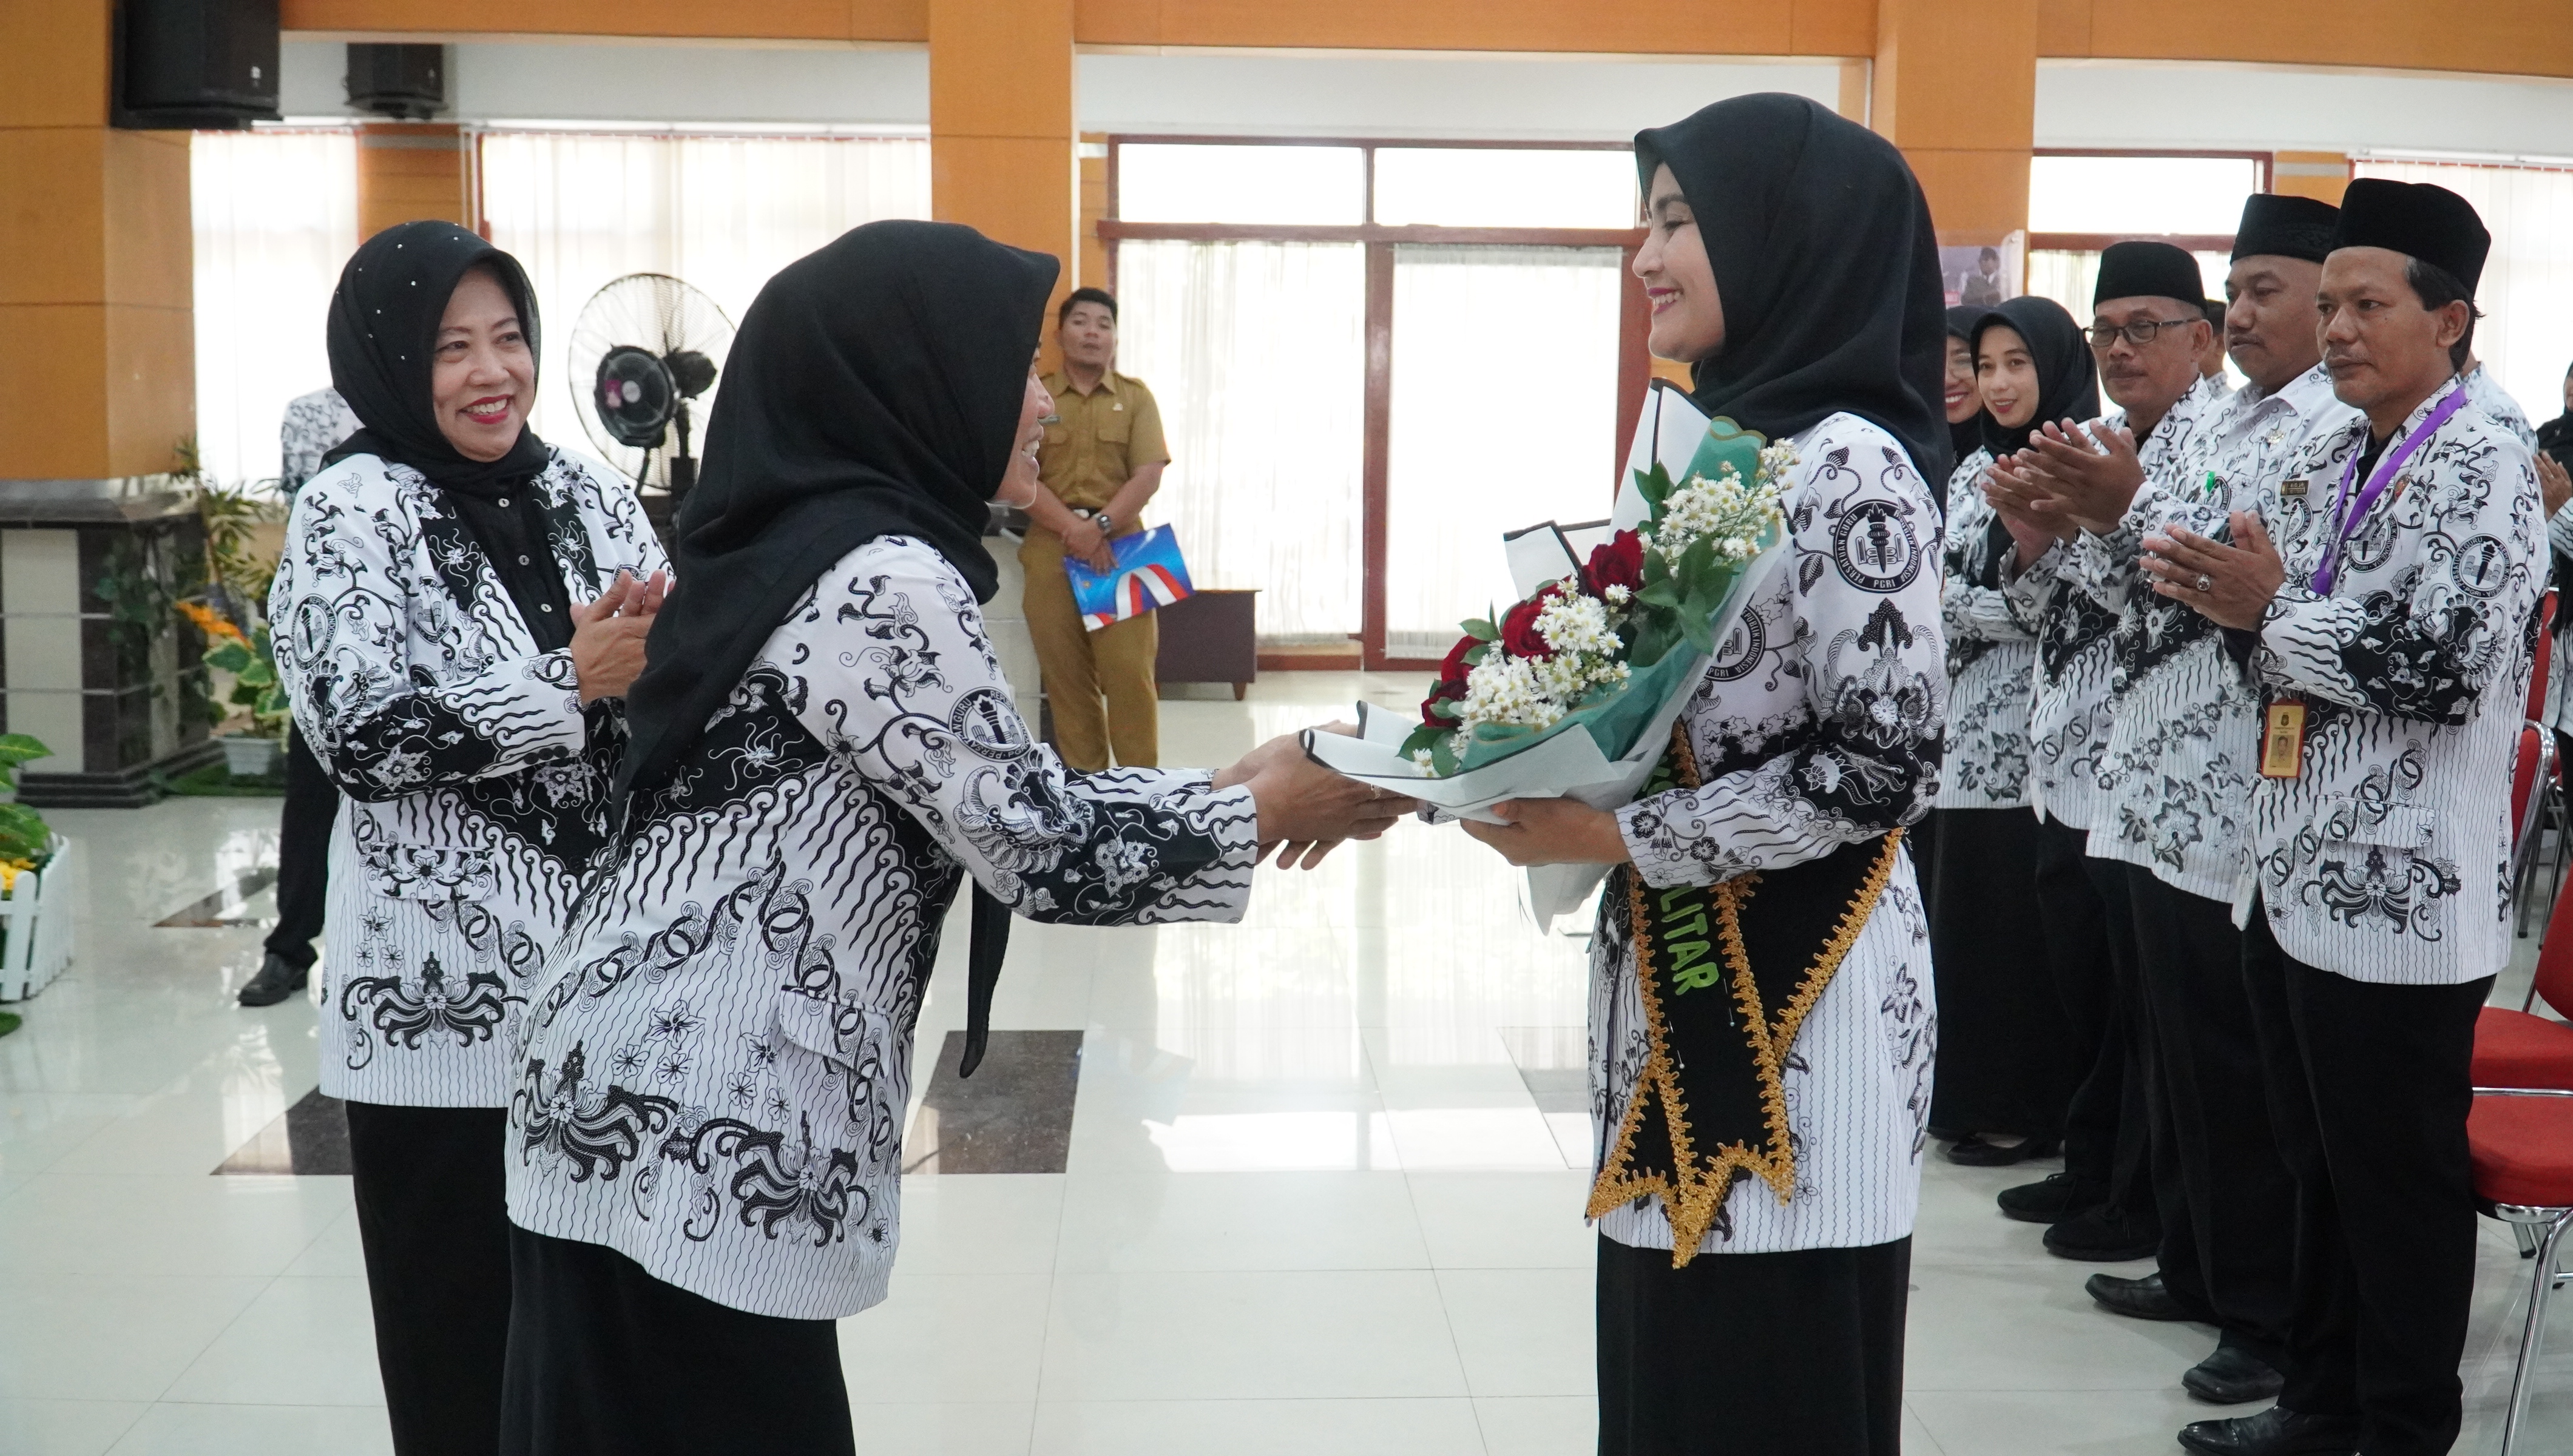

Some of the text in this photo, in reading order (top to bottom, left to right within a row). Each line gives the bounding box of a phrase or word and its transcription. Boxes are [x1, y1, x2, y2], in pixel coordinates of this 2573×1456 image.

[1839, 513, 1858, 536] GURU
[2464, 536, 2483, 548] GURU
[1838, 540, 1865, 584] PERSATUAN
[1901, 546, 1918, 582] INDONESIA
[1873, 579, 1896, 588] PGRI
[2464, 587, 2481, 596] PGRI
[1735, 639, 1760, 673] INDONESIA
[1708, 667, 1729, 677] PGRI
[953, 698, 972, 722] GURU
[1660, 885, 1720, 996] LITAR
